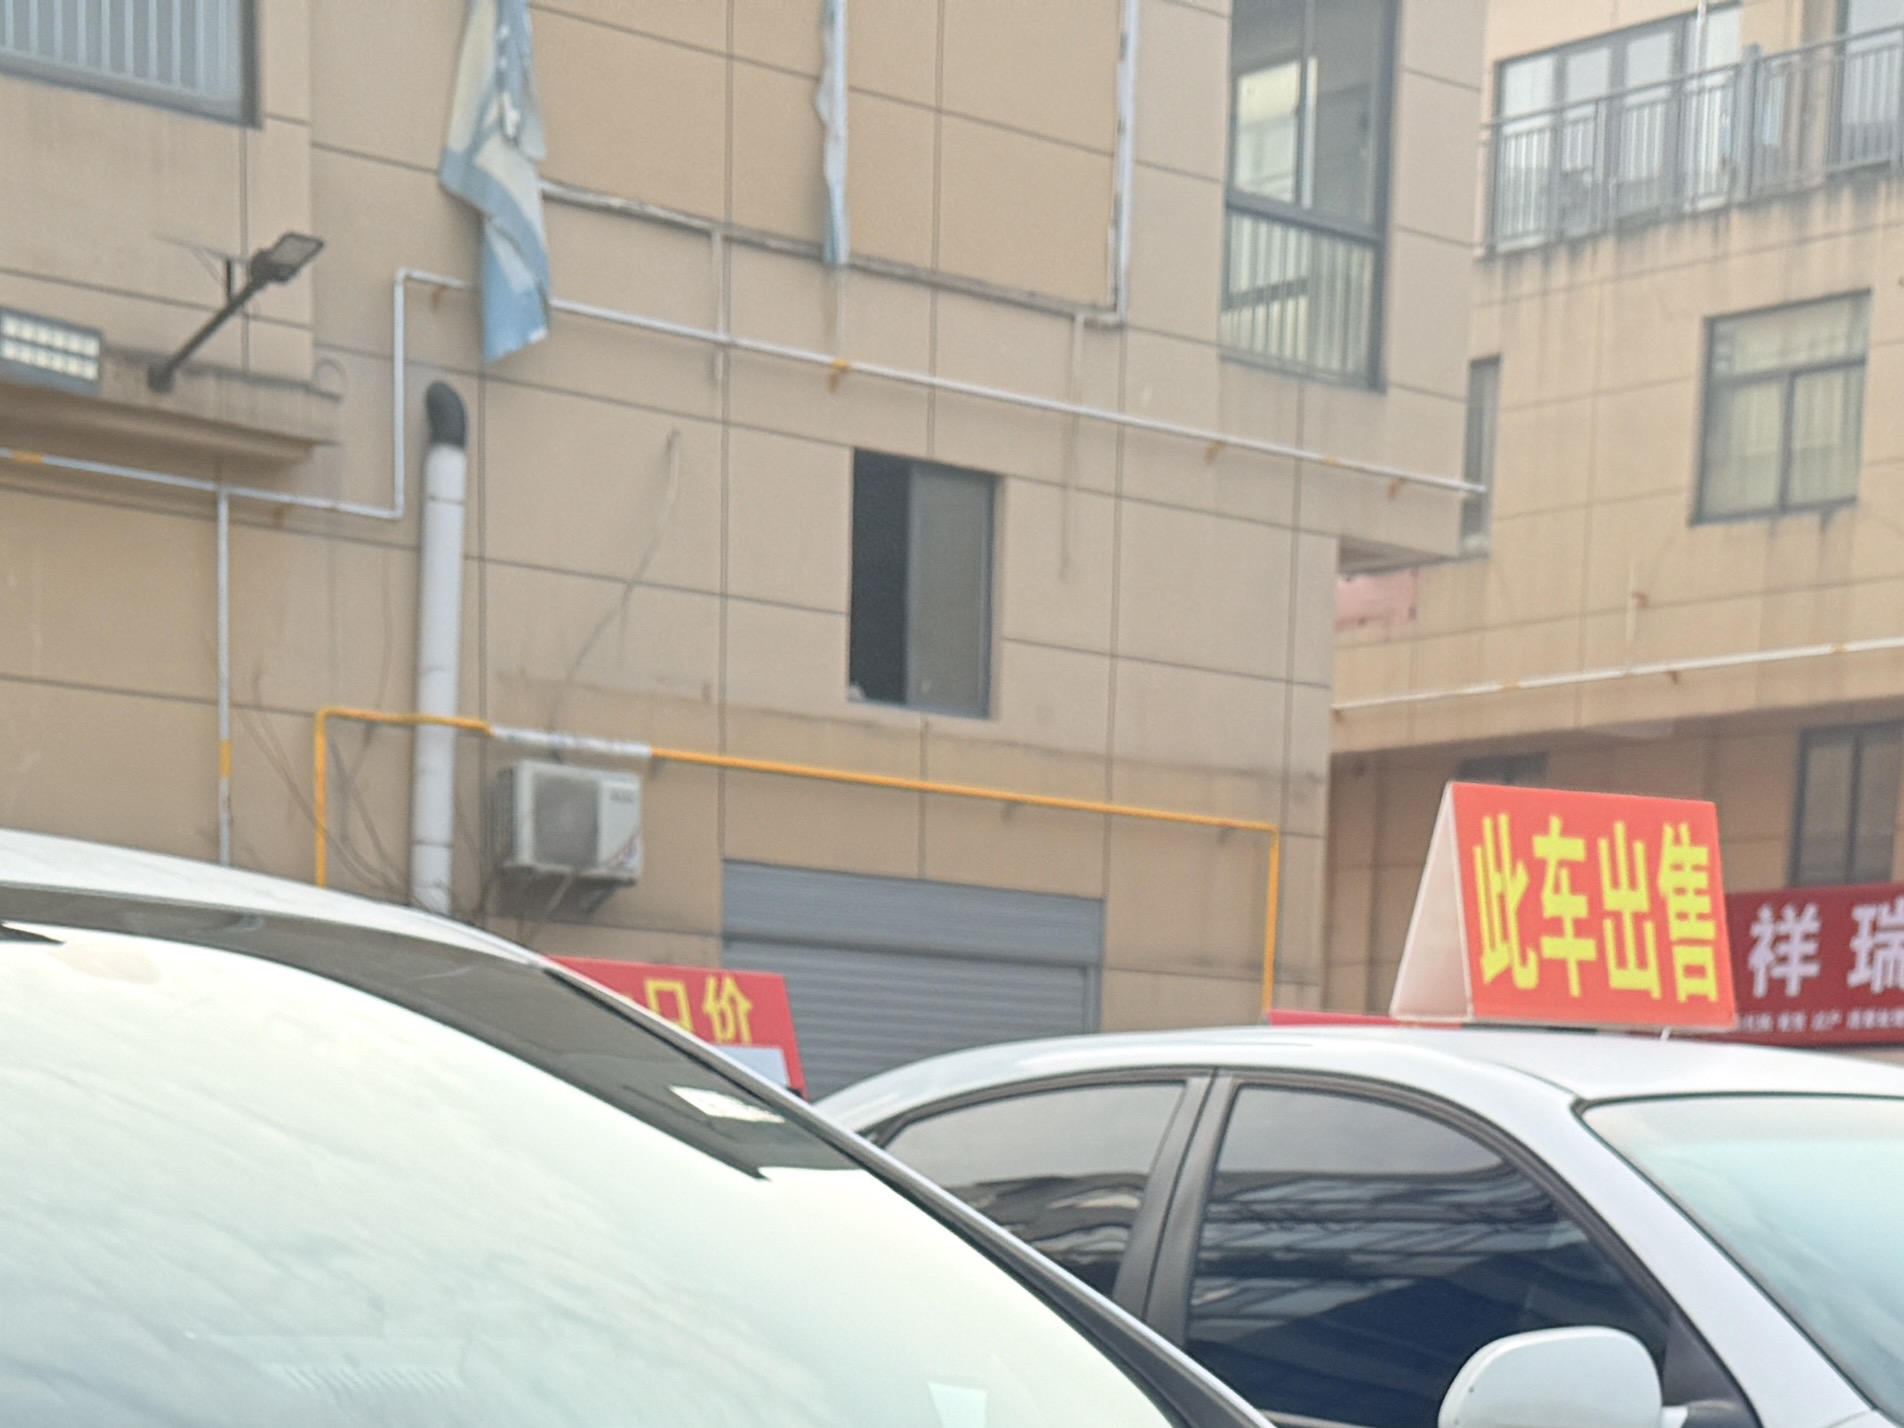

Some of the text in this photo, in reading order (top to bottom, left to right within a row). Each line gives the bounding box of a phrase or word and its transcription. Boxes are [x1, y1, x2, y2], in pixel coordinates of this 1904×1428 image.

[1473, 813, 1719, 1003] 此车出售
[624, 975, 753, 1044] 口价
